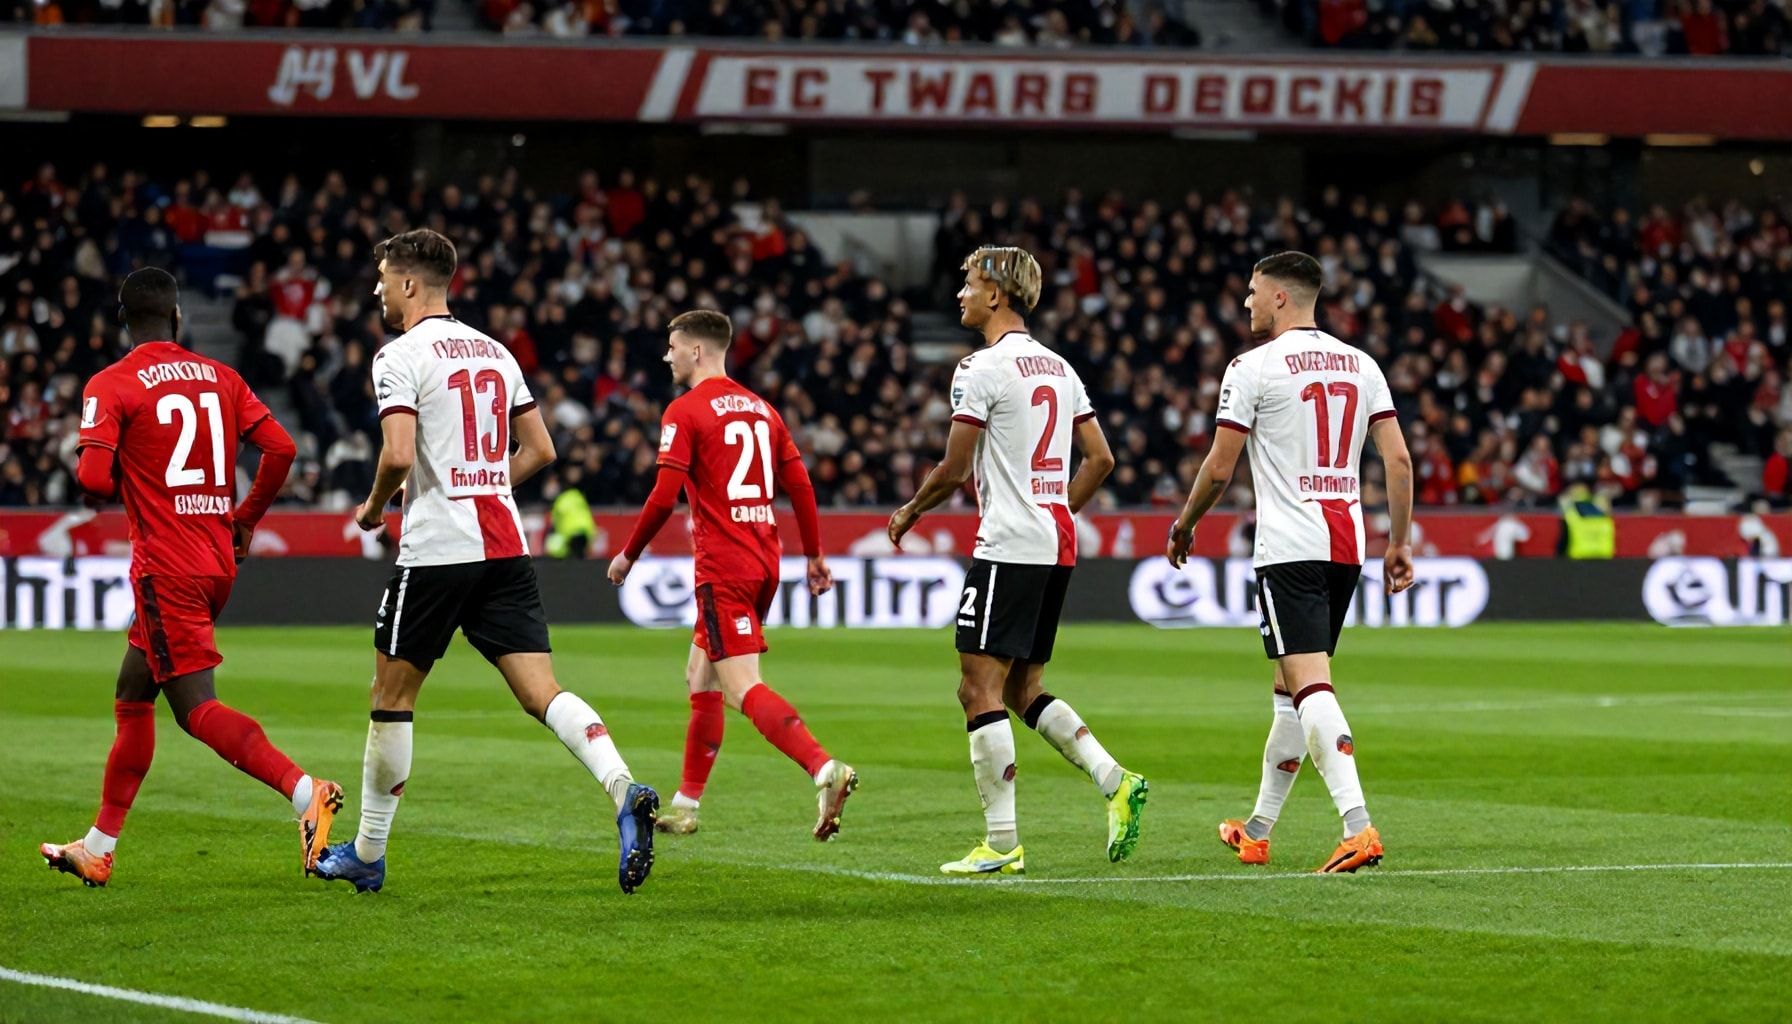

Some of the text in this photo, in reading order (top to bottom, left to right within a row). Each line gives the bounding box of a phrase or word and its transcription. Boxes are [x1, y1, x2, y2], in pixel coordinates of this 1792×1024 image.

[156, 392, 226, 487] 21
[448, 368, 508, 463] 13
[1031, 385, 1063, 471] 2
[1300, 381, 1359, 469] 17
[724, 420, 774, 500] 21
[960, 586, 977, 616] 2
